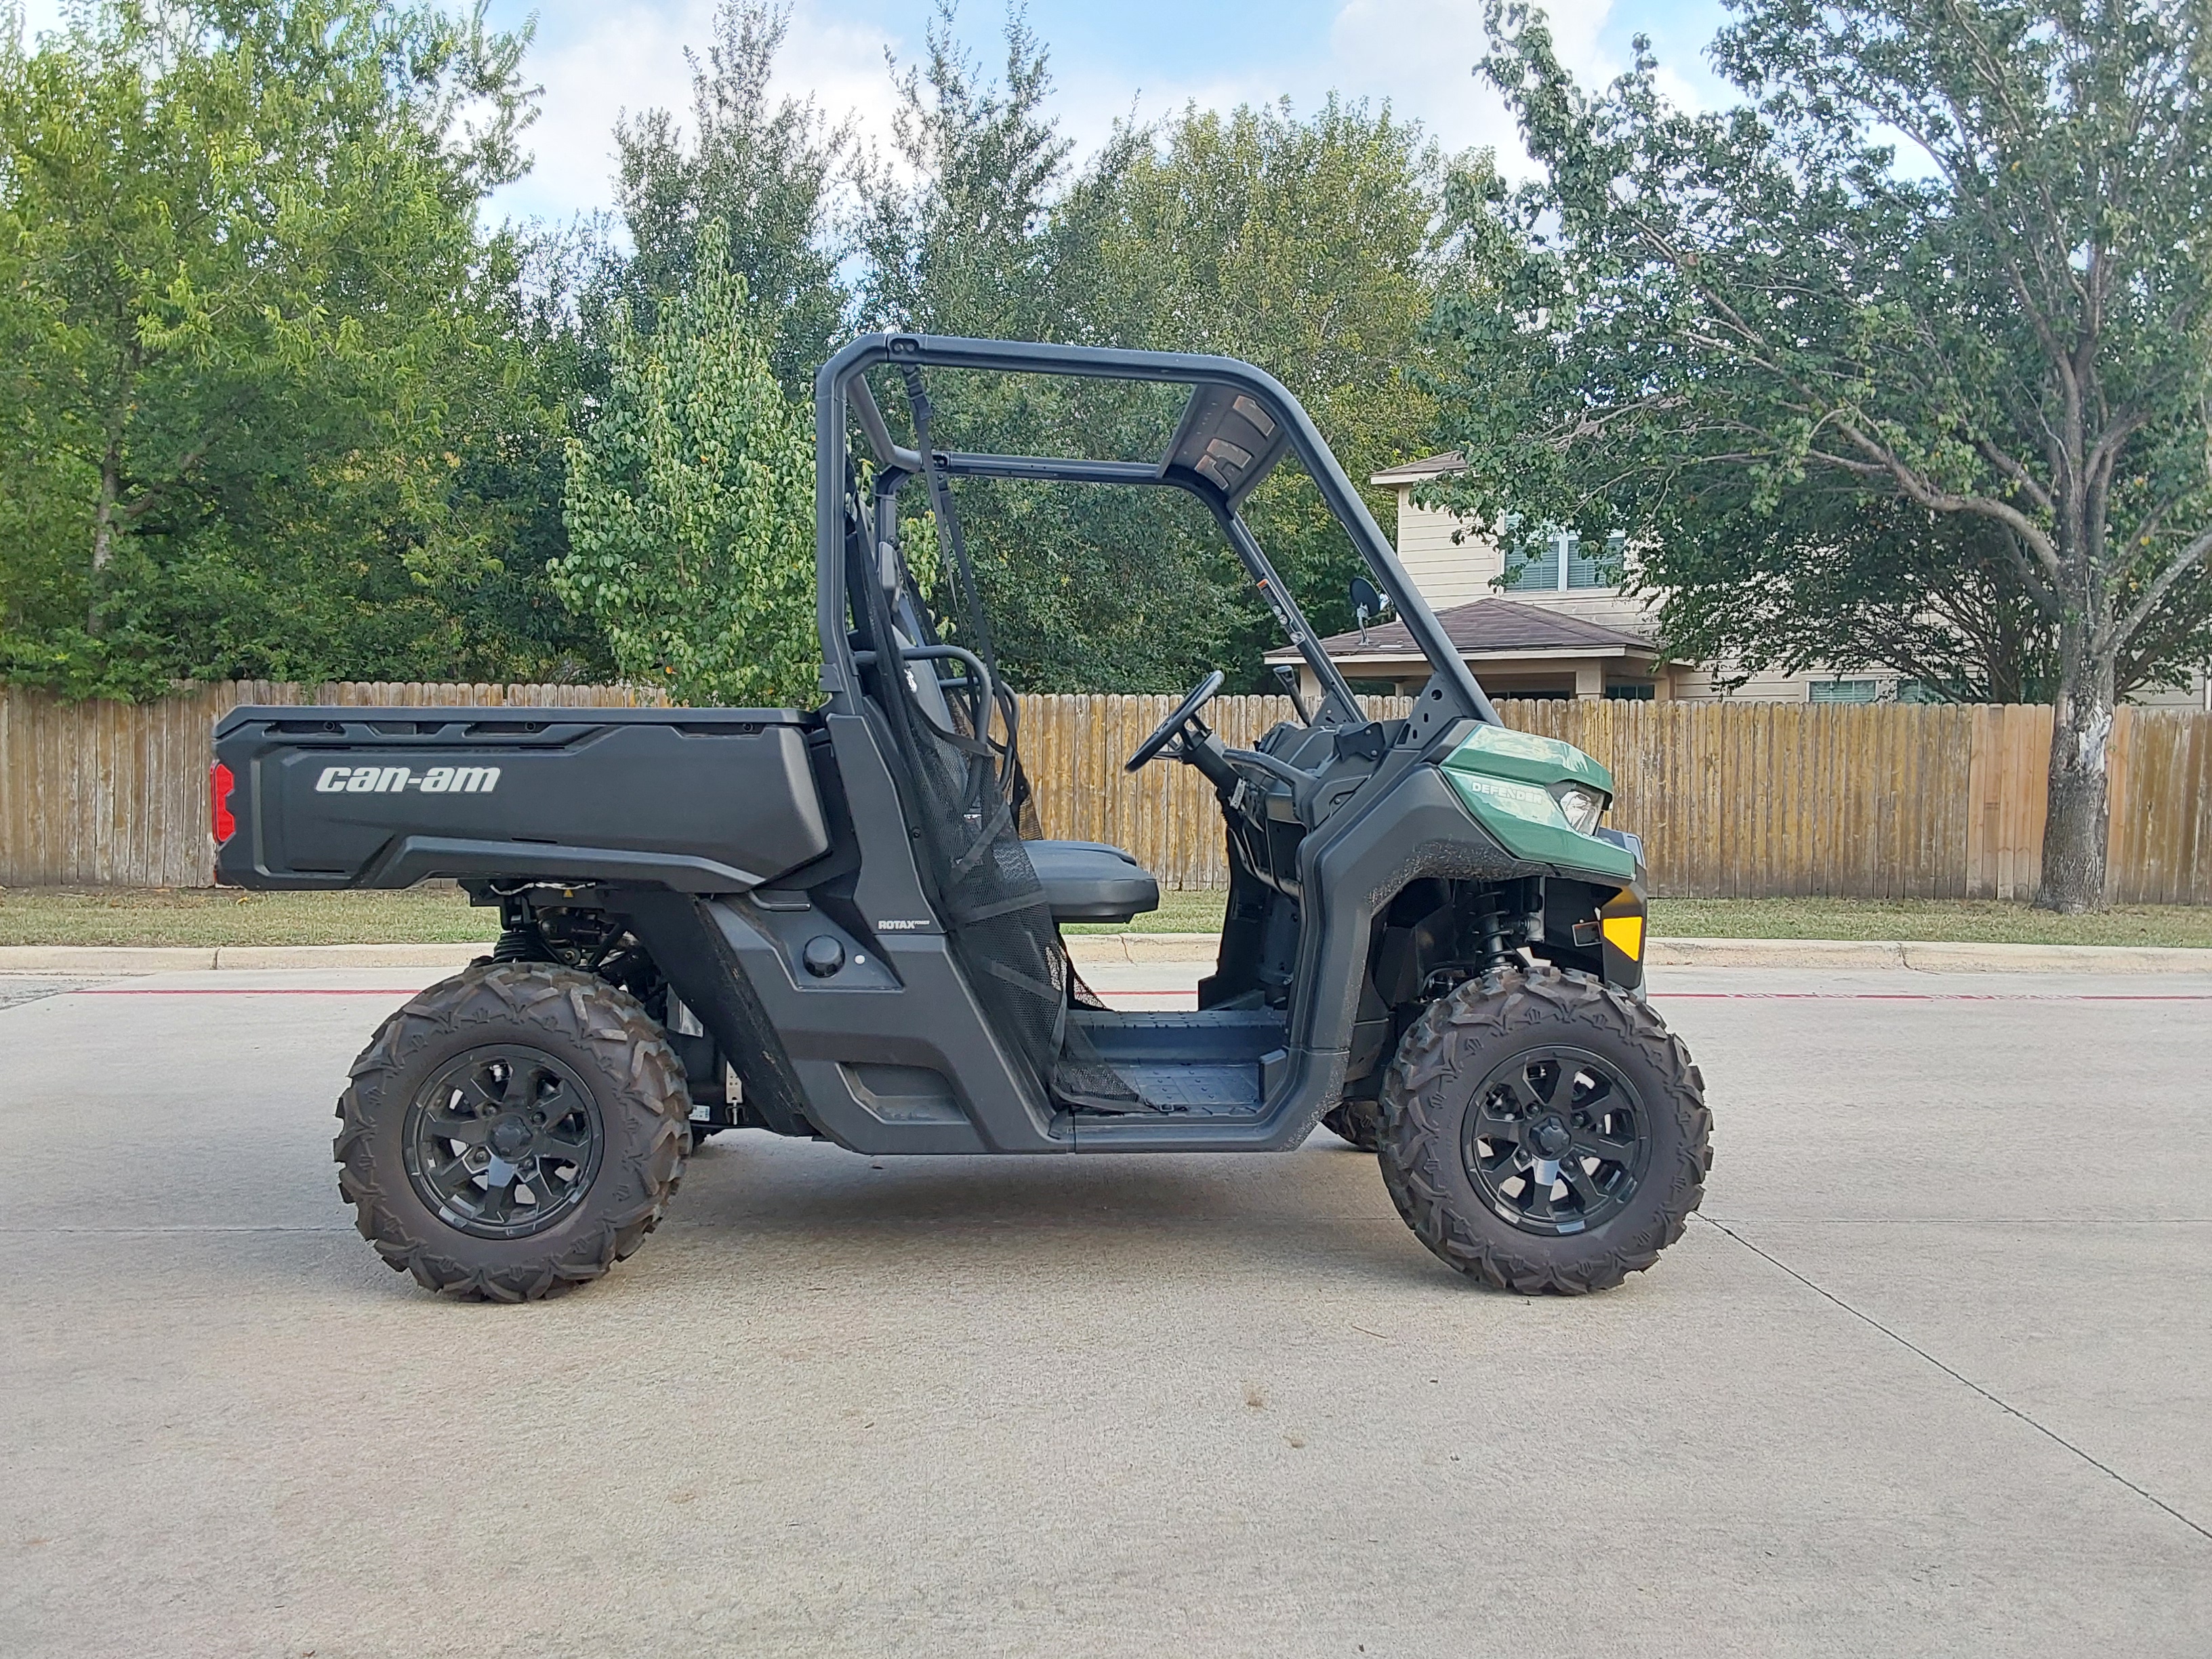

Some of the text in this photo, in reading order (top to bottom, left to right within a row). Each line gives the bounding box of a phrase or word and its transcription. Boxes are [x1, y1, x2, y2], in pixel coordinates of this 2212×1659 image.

[315, 767, 501, 792] can-am
[1472, 781, 1543, 804] DEFENDER
[878, 920, 915, 929] ROTAX
